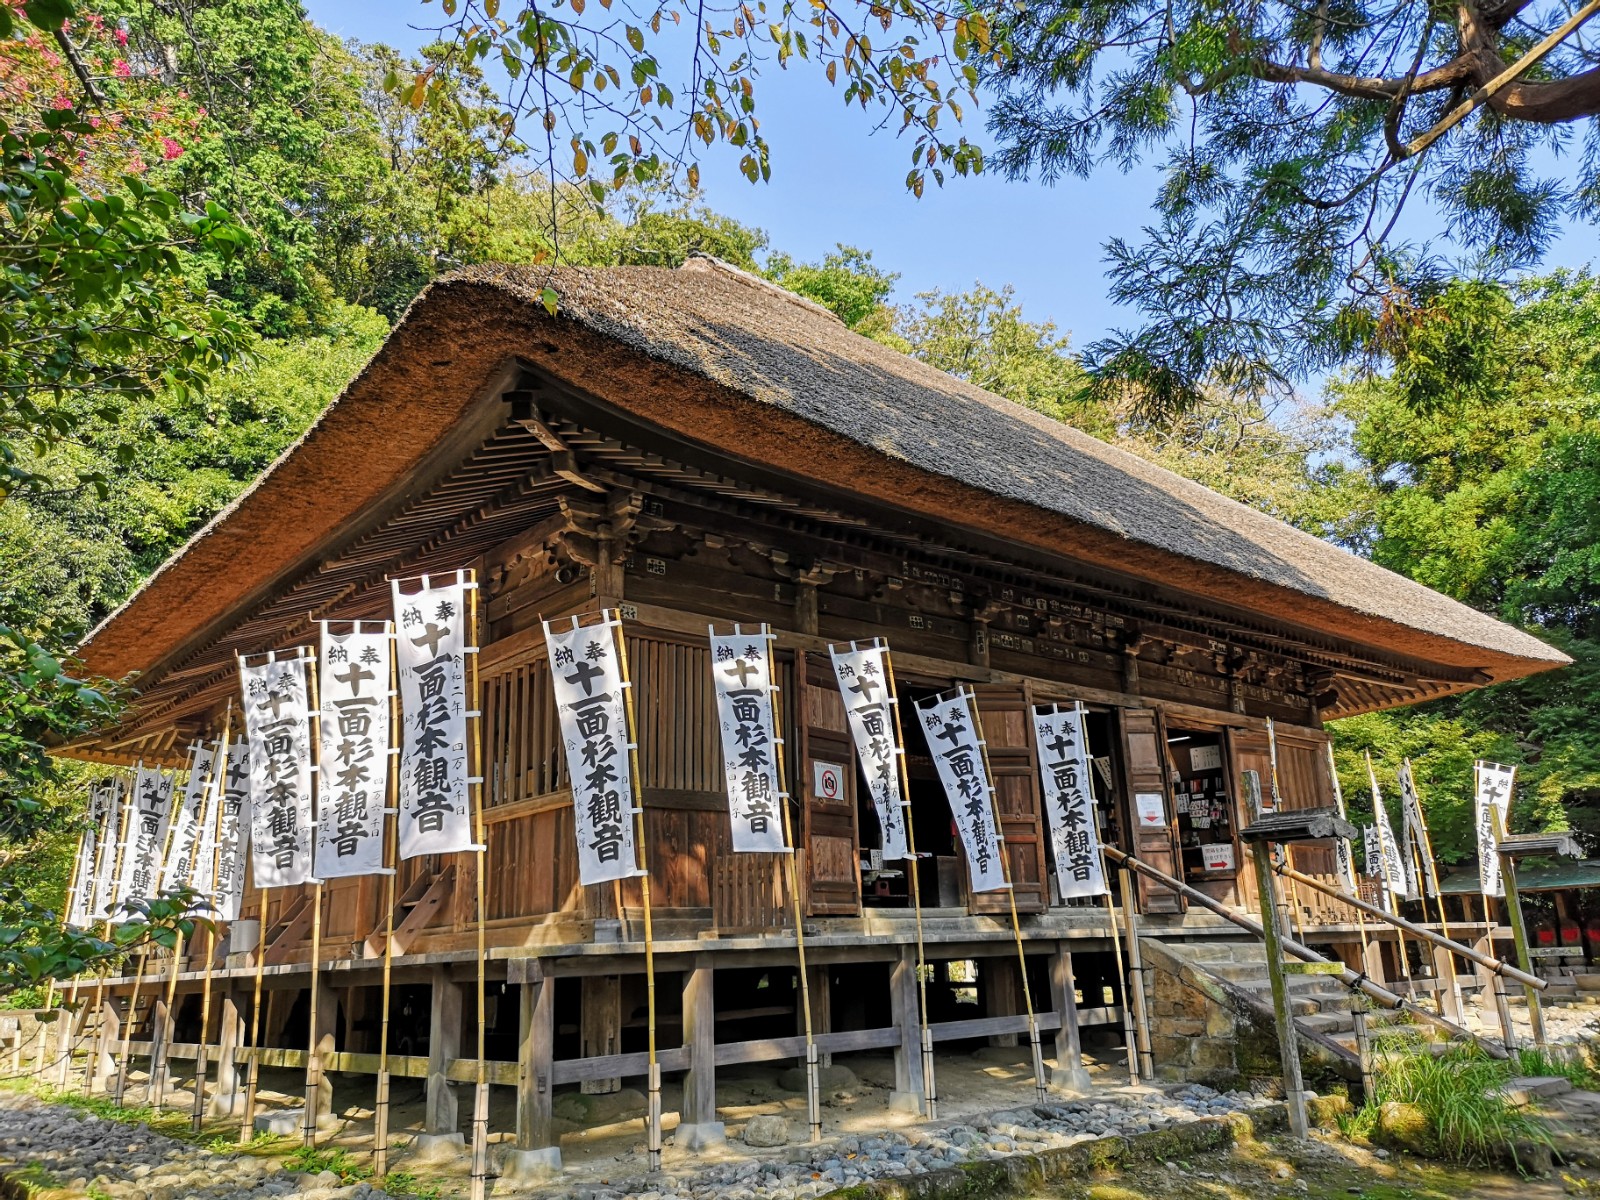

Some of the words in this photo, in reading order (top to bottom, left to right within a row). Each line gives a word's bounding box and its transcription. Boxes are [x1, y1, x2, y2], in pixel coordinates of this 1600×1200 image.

[329, 661, 376, 858] 十一面杉本観音
[410, 622, 454, 834] 十一面杉本観音
[451, 654, 464, 716] 令和二年
[564, 661, 624, 864] 十一面杉本観音
[723, 658, 772, 834] 十一面杉本観音
[256, 690, 300, 870] 十一面杉本観音
[452, 742, 466, 816] 四万六千日
[935, 722, 992, 875] 十一面杉本観音
[1046, 734, 1095, 882] 十一面杉本観音
